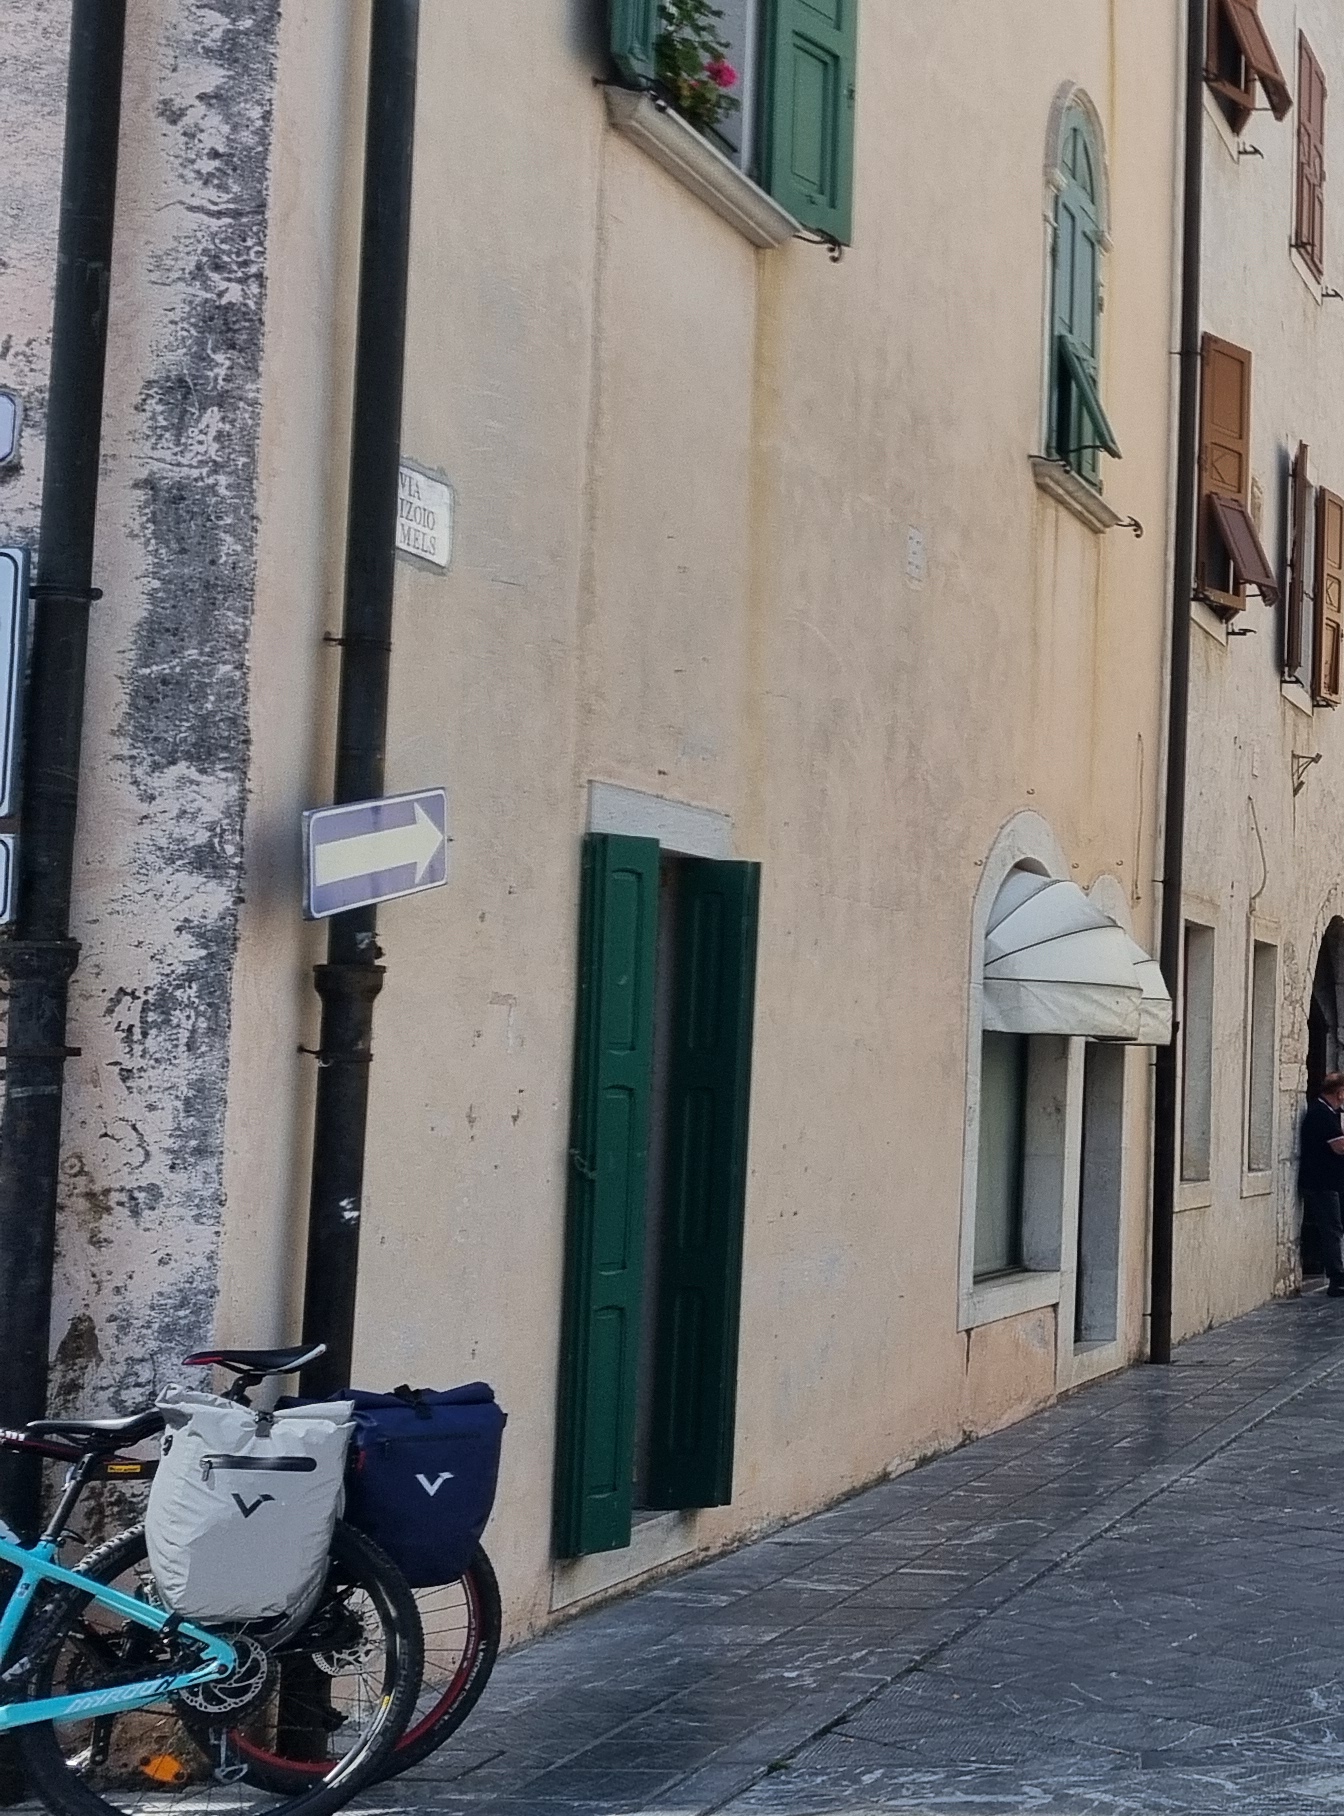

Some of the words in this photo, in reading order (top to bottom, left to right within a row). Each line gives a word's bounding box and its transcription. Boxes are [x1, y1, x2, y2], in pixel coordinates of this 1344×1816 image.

[400, 472, 422, 500] VIA
[400, 498, 435, 531] IZOIO
[400, 523, 436, 555] MELS
